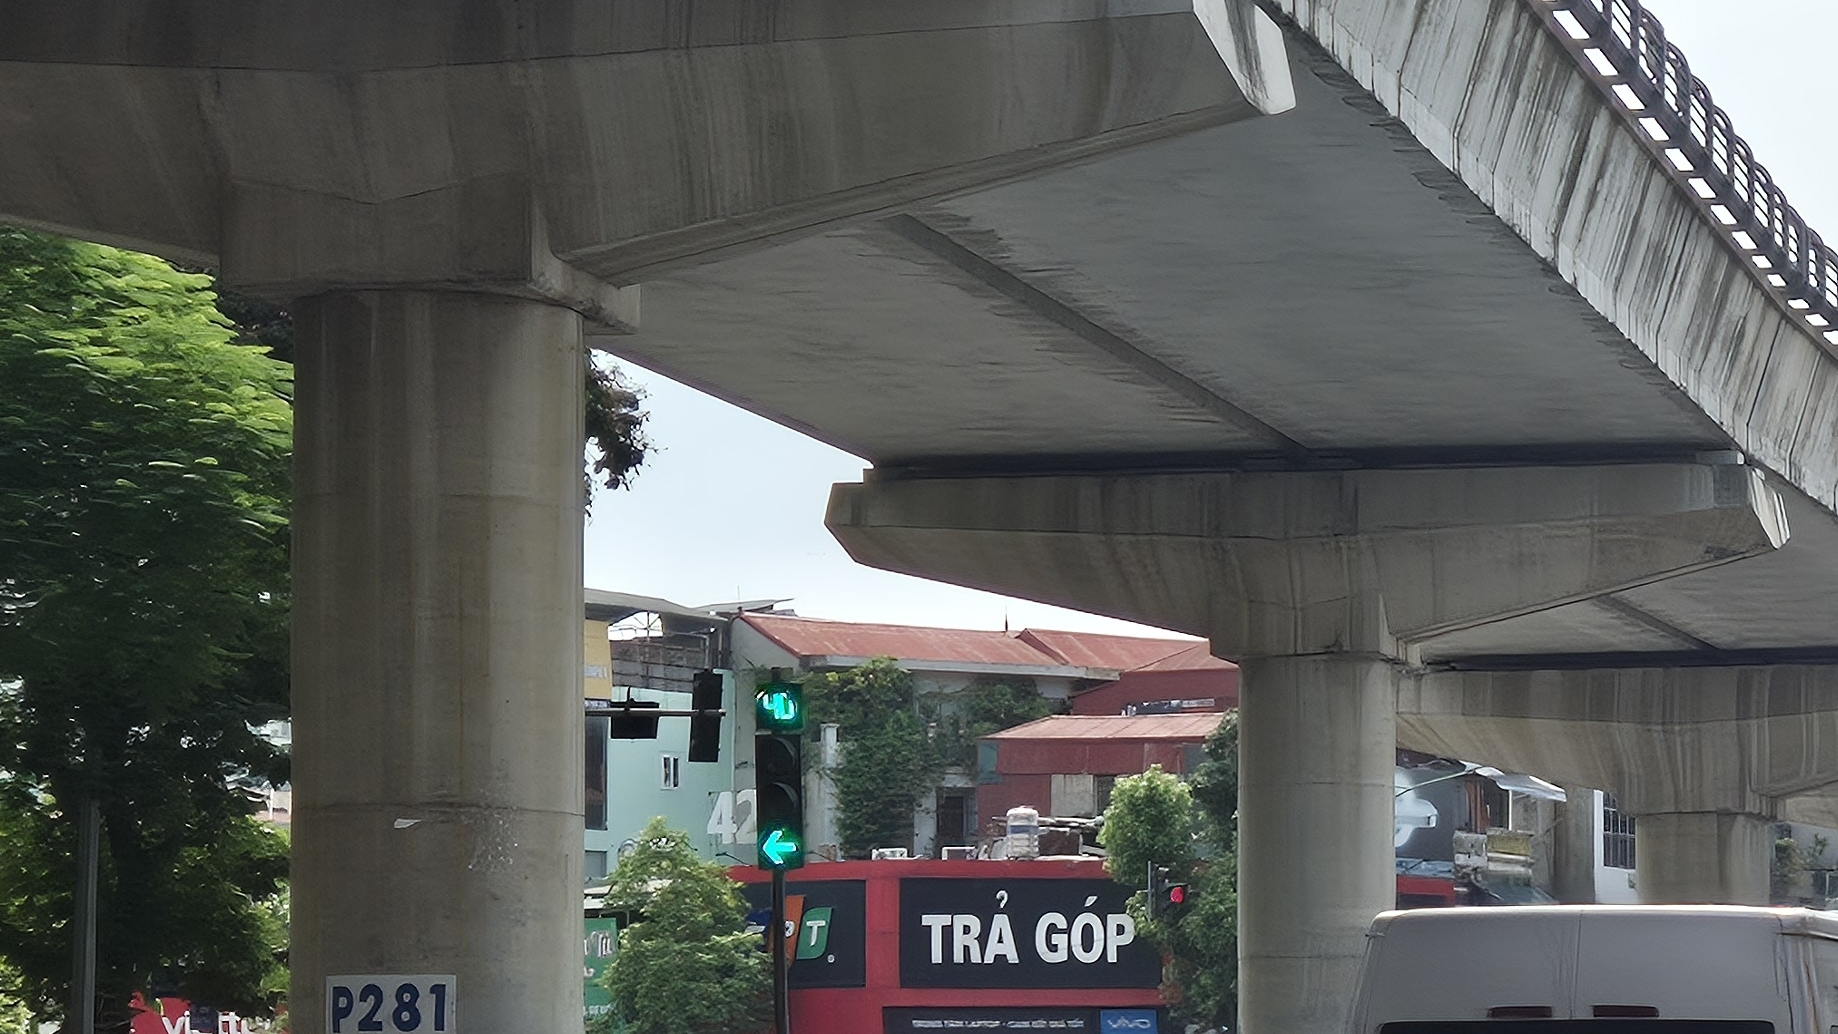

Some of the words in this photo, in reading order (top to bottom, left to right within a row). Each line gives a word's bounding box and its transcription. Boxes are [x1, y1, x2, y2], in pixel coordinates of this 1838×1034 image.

[921, 889, 1020, 964] TRẢ
[1035, 895, 1138, 964] GÓP
[331, 983, 448, 1034] P281
